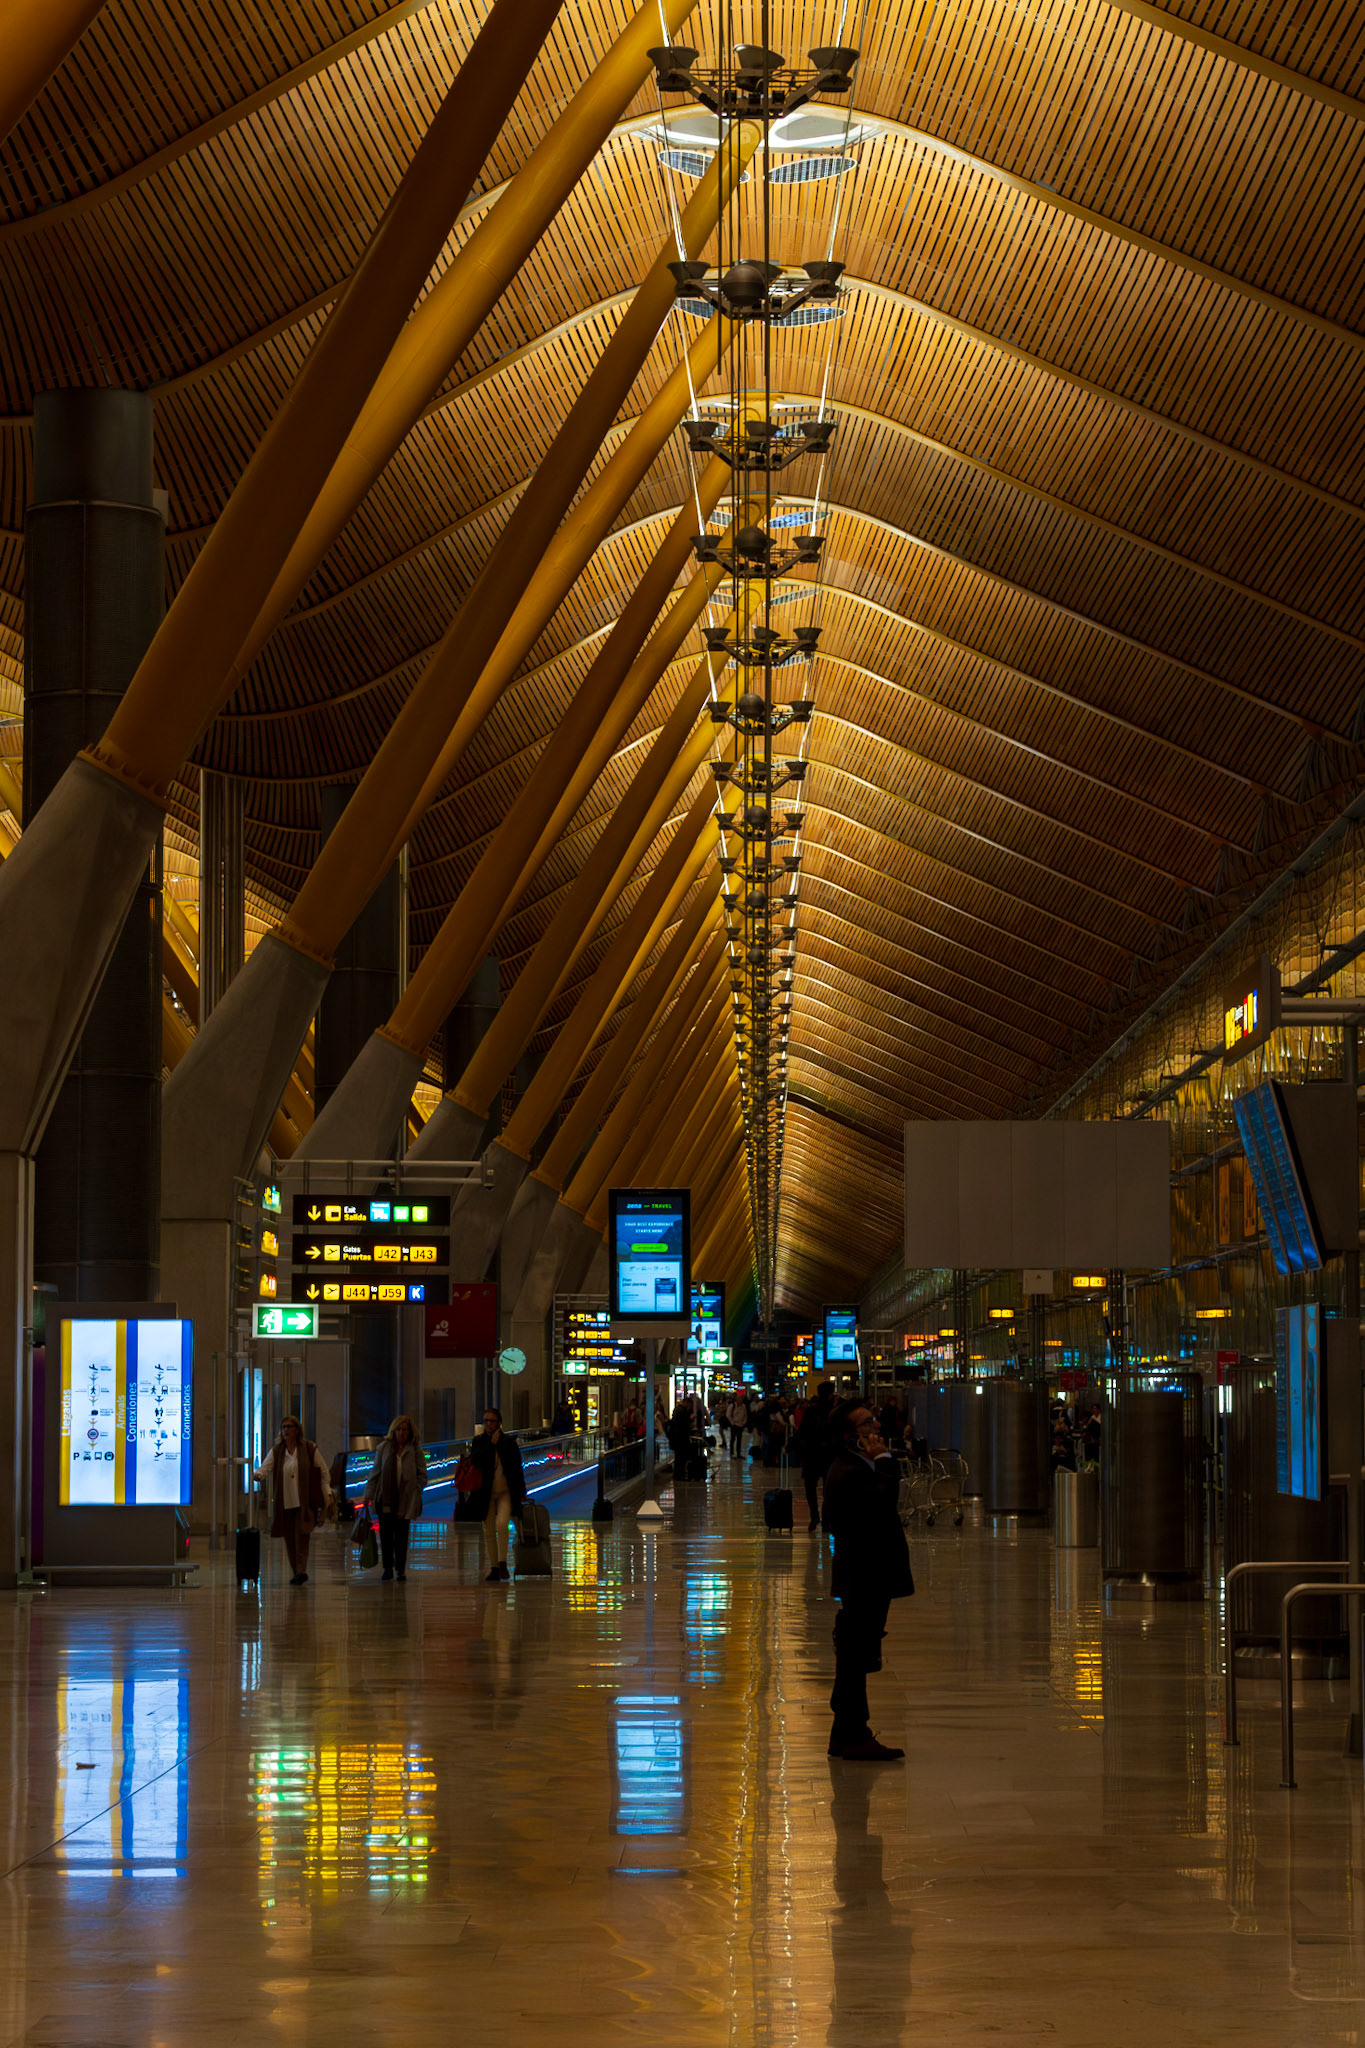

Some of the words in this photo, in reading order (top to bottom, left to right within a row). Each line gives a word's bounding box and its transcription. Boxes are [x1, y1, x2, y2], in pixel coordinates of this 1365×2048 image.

[343, 1206, 356, 1214] Exit
[395, 1209, 407, 1220] M
[415, 1209, 424, 1220] S
[343, 1214, 367, 1222] Salida
[343, 1246, 361, 1254] Gates
[377, 1250, 397, 1259] J42
[413, 1250, 433, 1260] J43
[342, 1253, 372, 1261] Puertas
[346, 1288, 366, 1298] J44
[382, 1288, 402, 1298] J59
[411, 1287, 421, 1299] K
[61, 1389, 72, 1436] Llegadas
[116, 1395, 125, 1430] Arrivals
[127, 1382, 137, 1442] Conexiones
[182, 1384, 191, 1440] Connections
